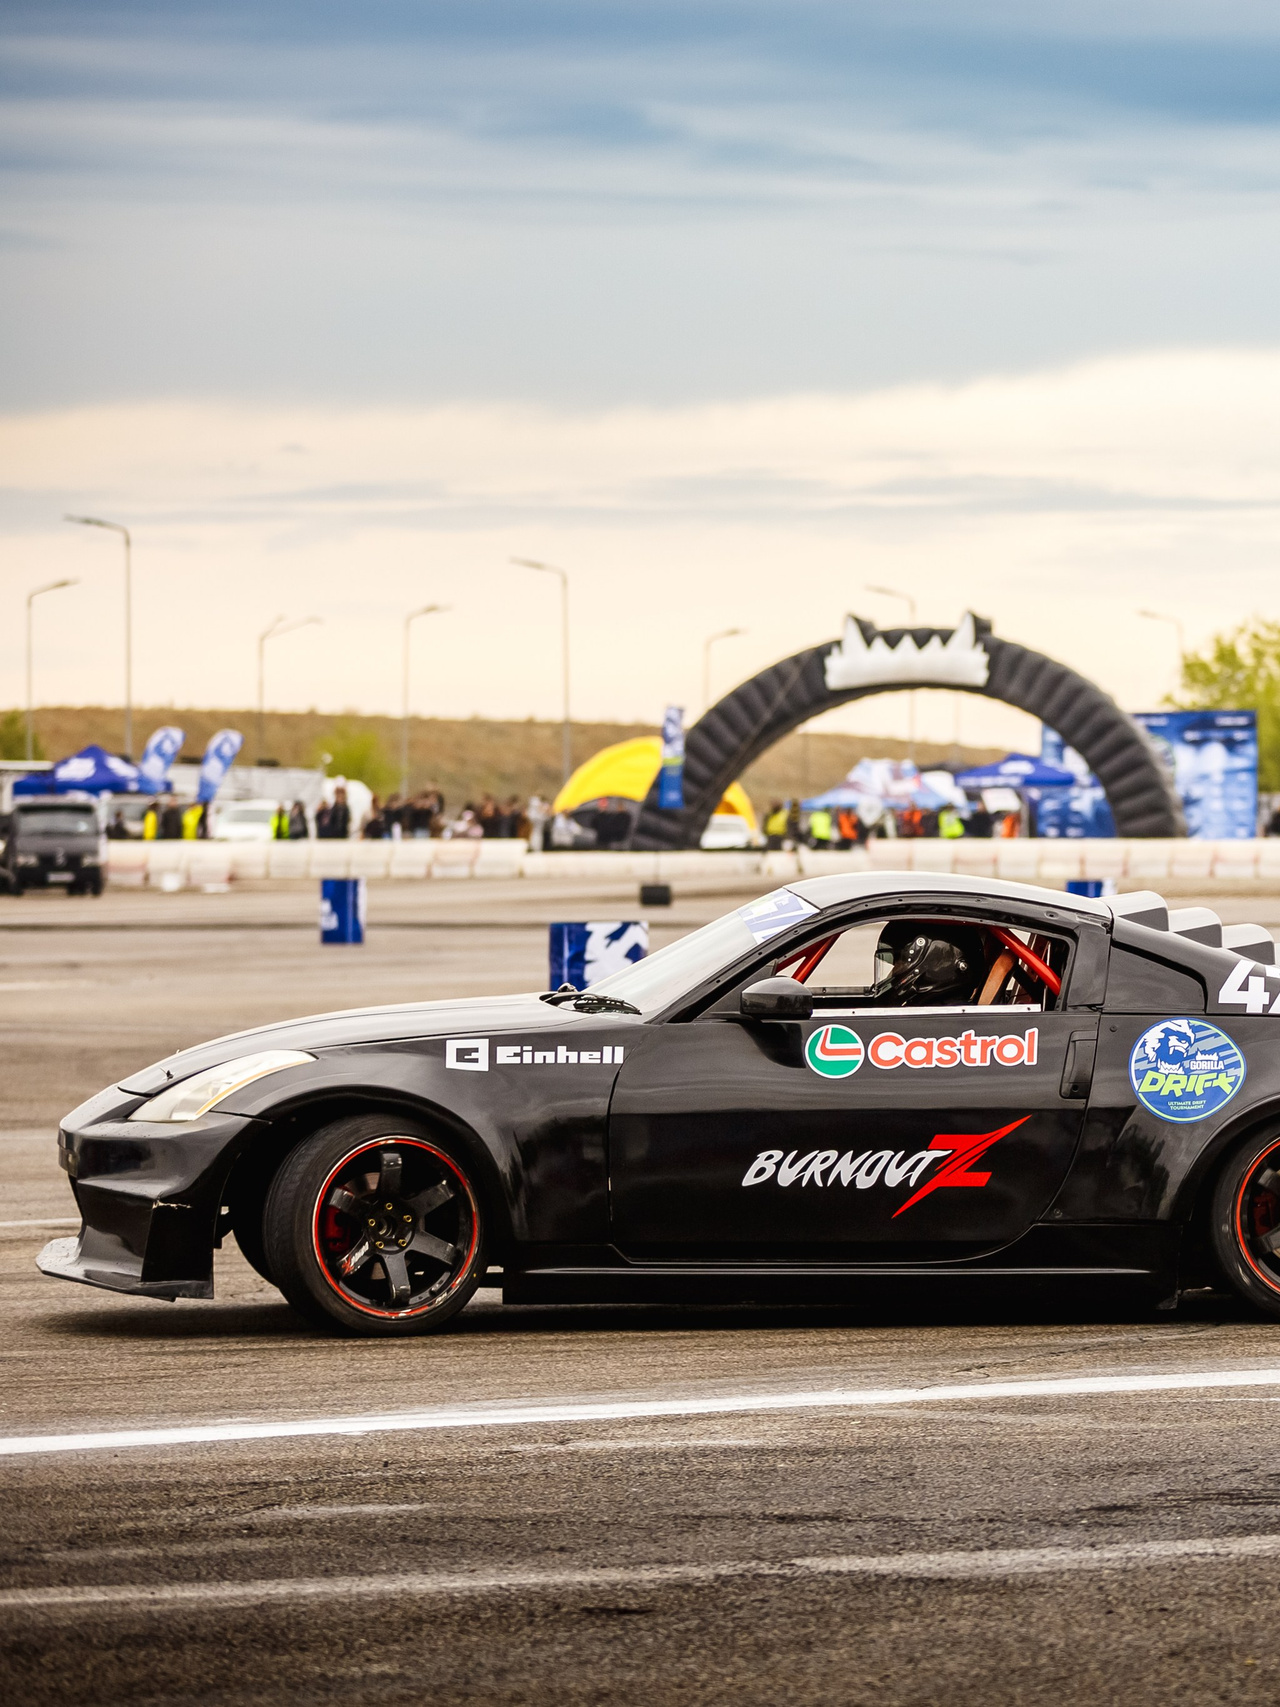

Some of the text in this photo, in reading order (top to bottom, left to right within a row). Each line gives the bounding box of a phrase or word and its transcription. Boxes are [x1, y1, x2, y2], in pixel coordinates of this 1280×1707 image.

[497, 1045, 625, 1065] Einhell
[868, 1029, 1038, 1069] Castrol
[1190, 1060, 1225, 1070] GORILLA
[1138, 1070, 1236, 1097] DRIFT
